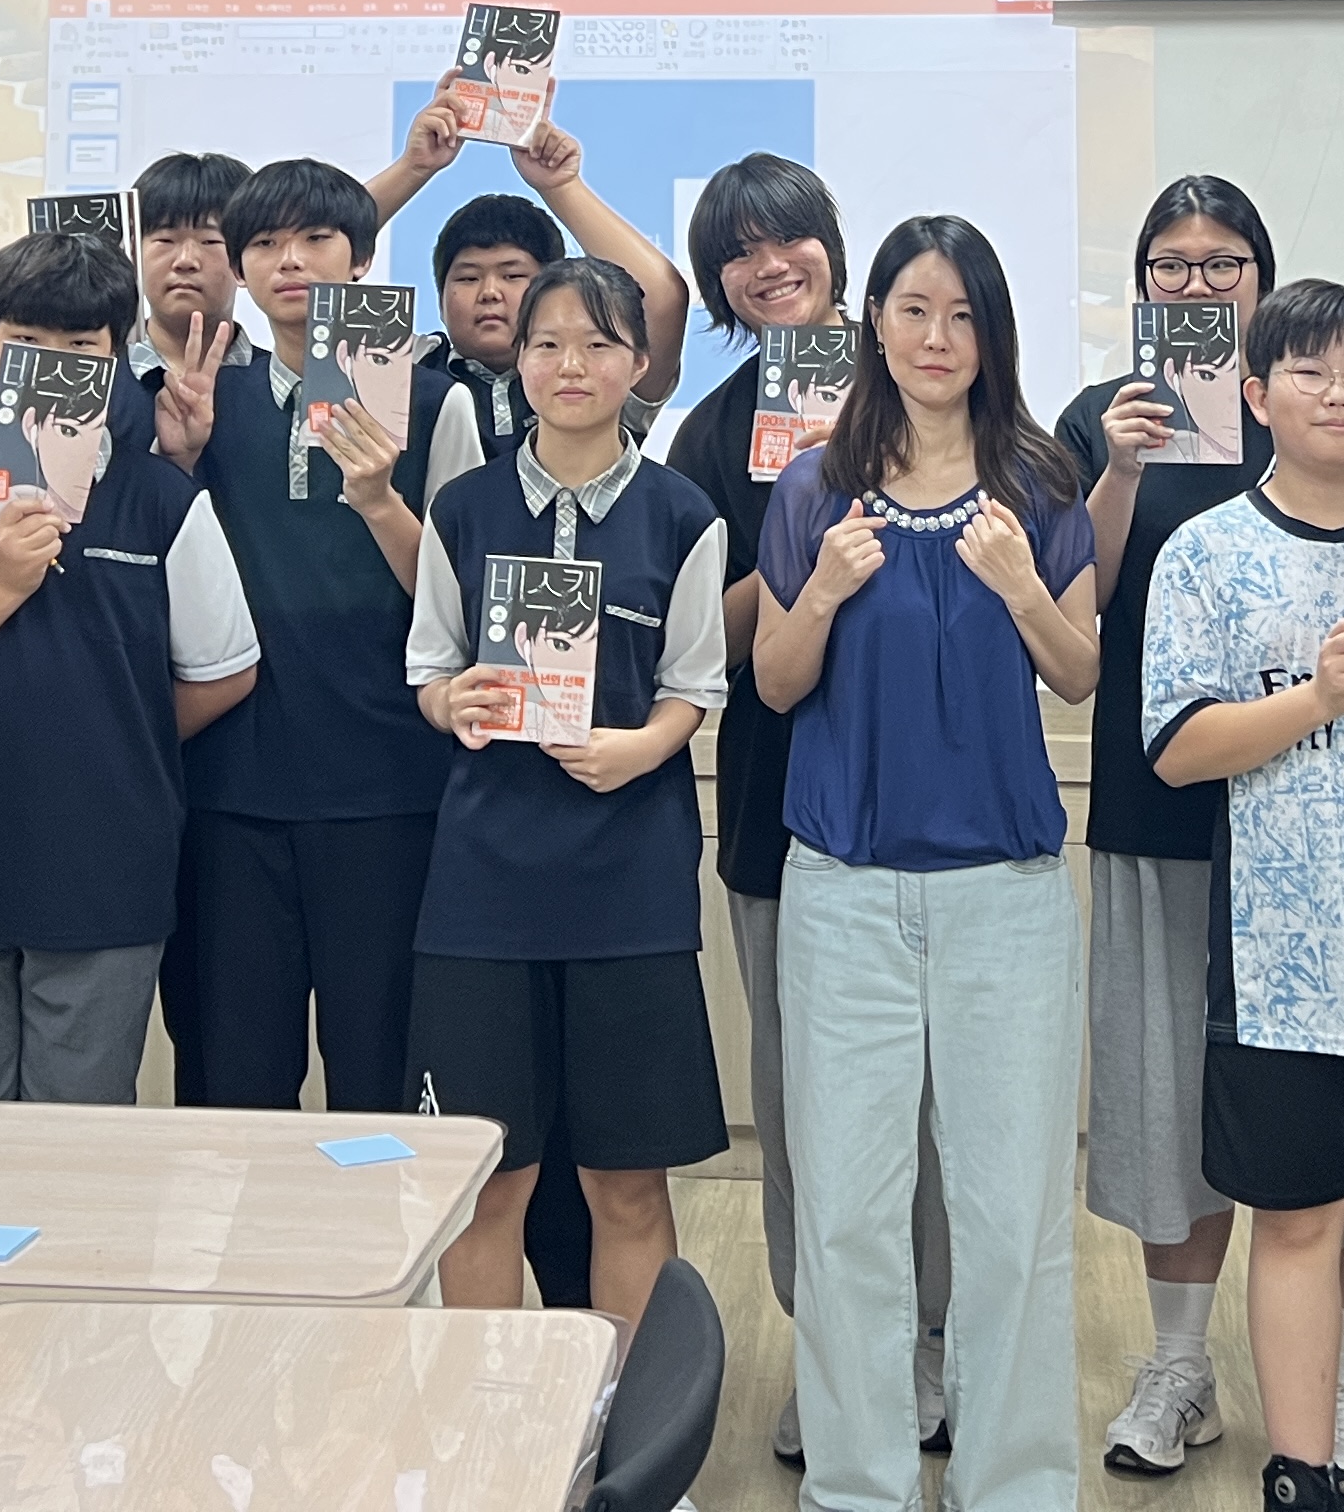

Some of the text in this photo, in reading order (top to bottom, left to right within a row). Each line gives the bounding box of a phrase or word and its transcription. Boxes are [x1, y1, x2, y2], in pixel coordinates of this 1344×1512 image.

[468, 7, 556, 46] 비스킷
[30, 197, 119, 238] 비스킷
[313, 287, 410, 329] 비스킷
[1137, 306, 1232, 346] 비스킷
[765, 329, 858, 369] 비스킷
[2, 348, 110, 401] 비스킷
[489, 562, 595, 612] 비스킷
[1295, 719, 1334, 751] LY
